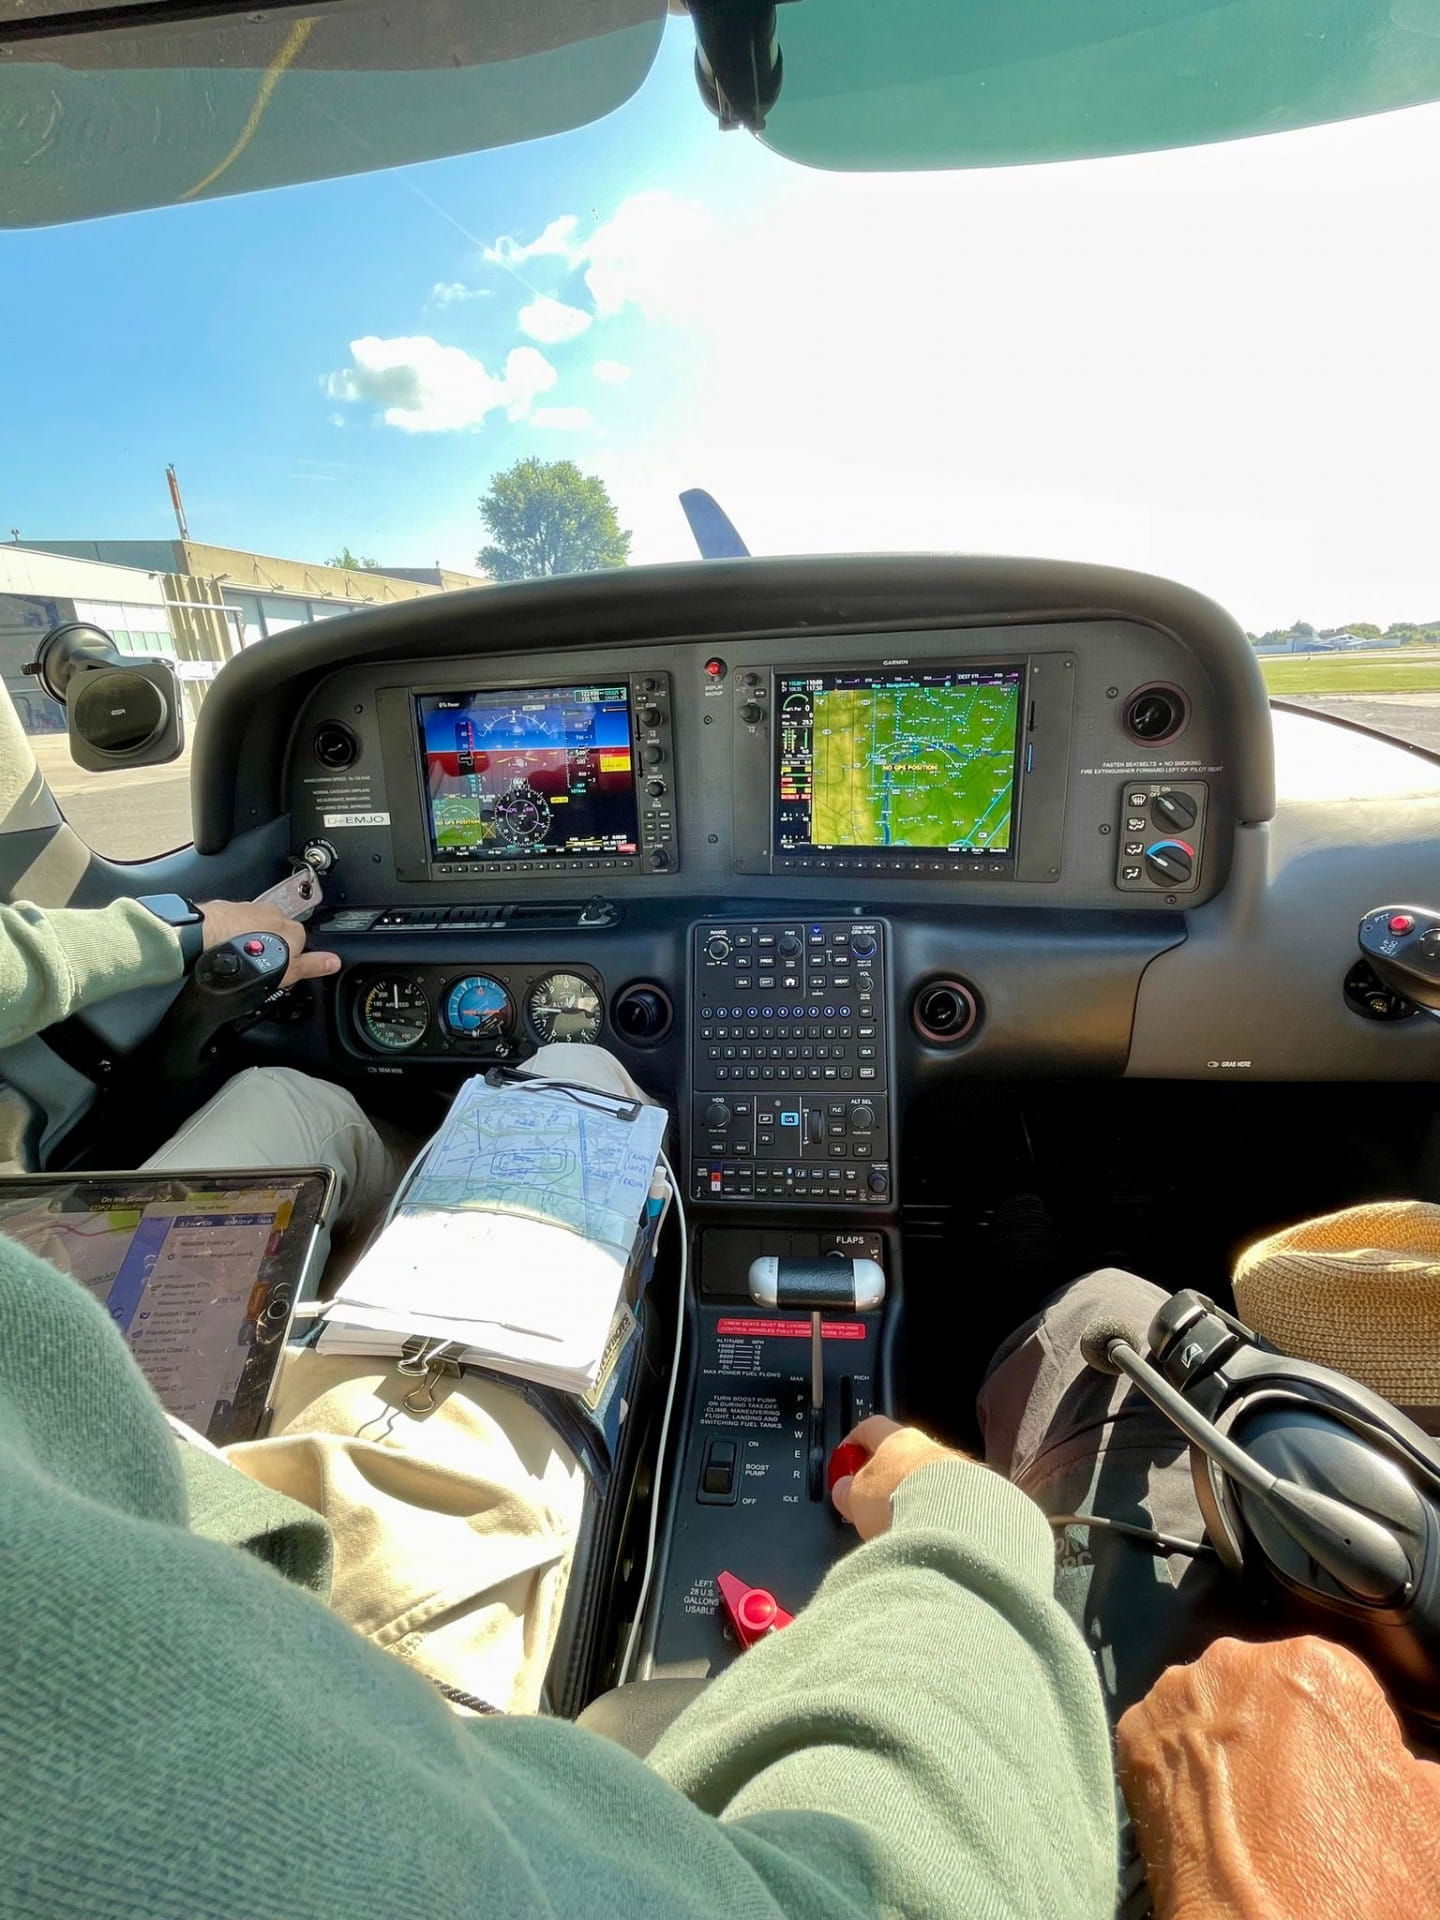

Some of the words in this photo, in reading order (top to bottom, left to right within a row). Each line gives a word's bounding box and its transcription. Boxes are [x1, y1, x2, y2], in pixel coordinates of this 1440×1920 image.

[836, 1236, 864, 1244] FLAPS
[730, 1408, 781, 1416] MANEUVERING
[700, 1418, 739, 1426] SWITCHING
[694, 1579, 714, 1587] LEFT
[683, 1596, 720, 1606] GALLONS
[685, 1605, 716, 1615] USABLE
